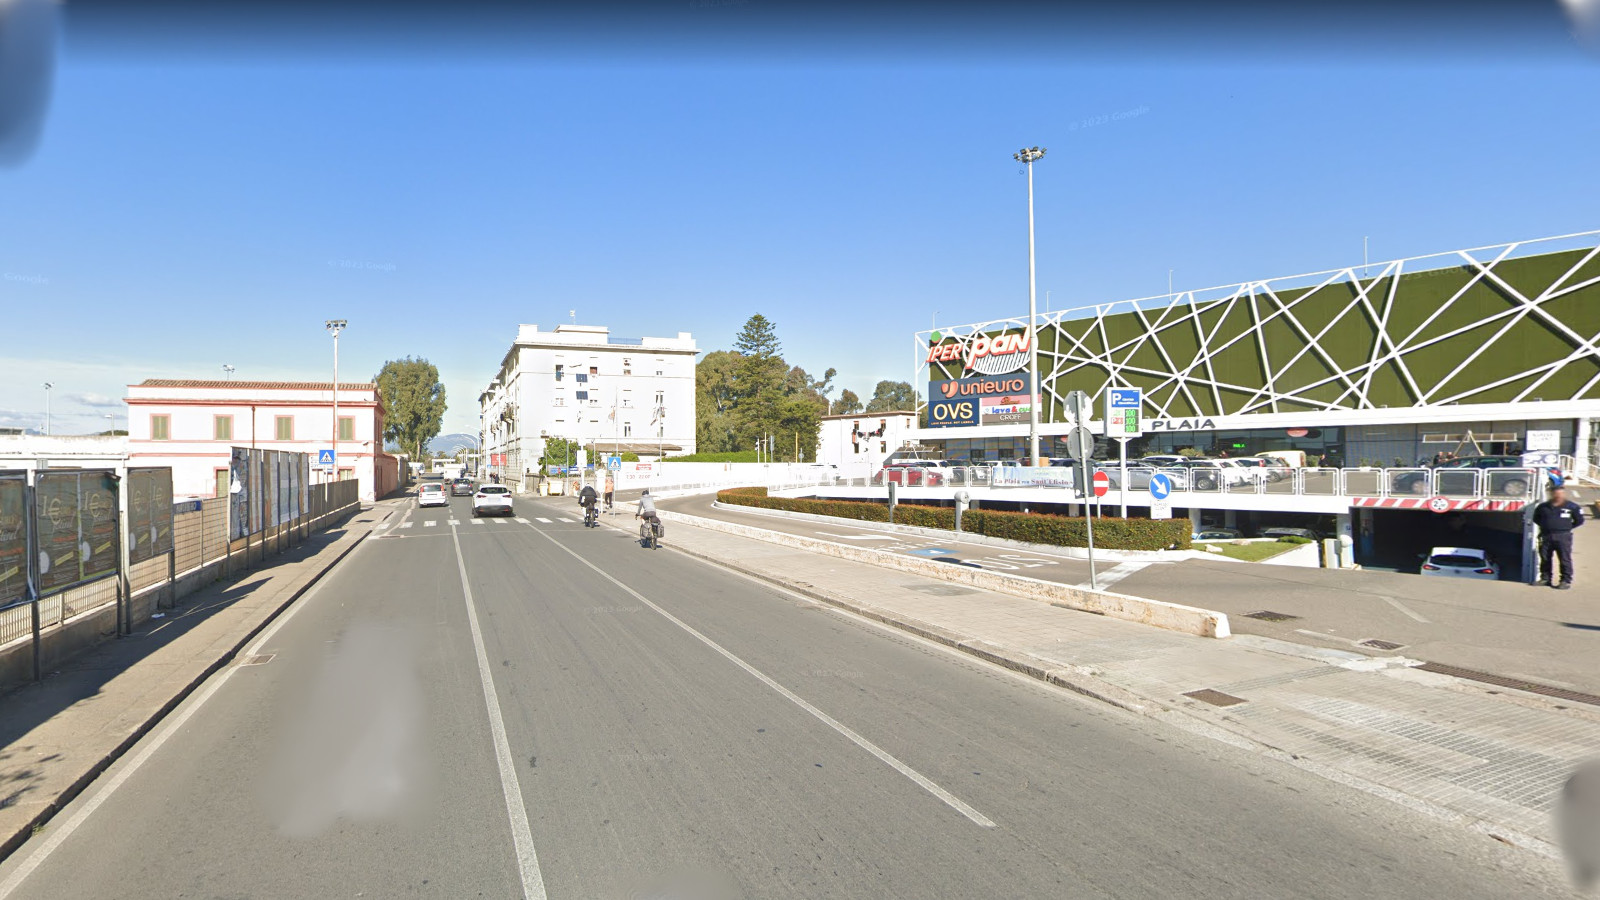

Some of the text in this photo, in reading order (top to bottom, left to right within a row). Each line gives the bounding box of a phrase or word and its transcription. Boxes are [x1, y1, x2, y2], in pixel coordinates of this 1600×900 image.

[926, 343, 963, 362] IPER
[960, 379, 1024, 395] unieuro
[1112, 392, 1122, 405] P
[934, 402, 973, 420] OVS
[1151, 418, 1216, 430] PLAIA
